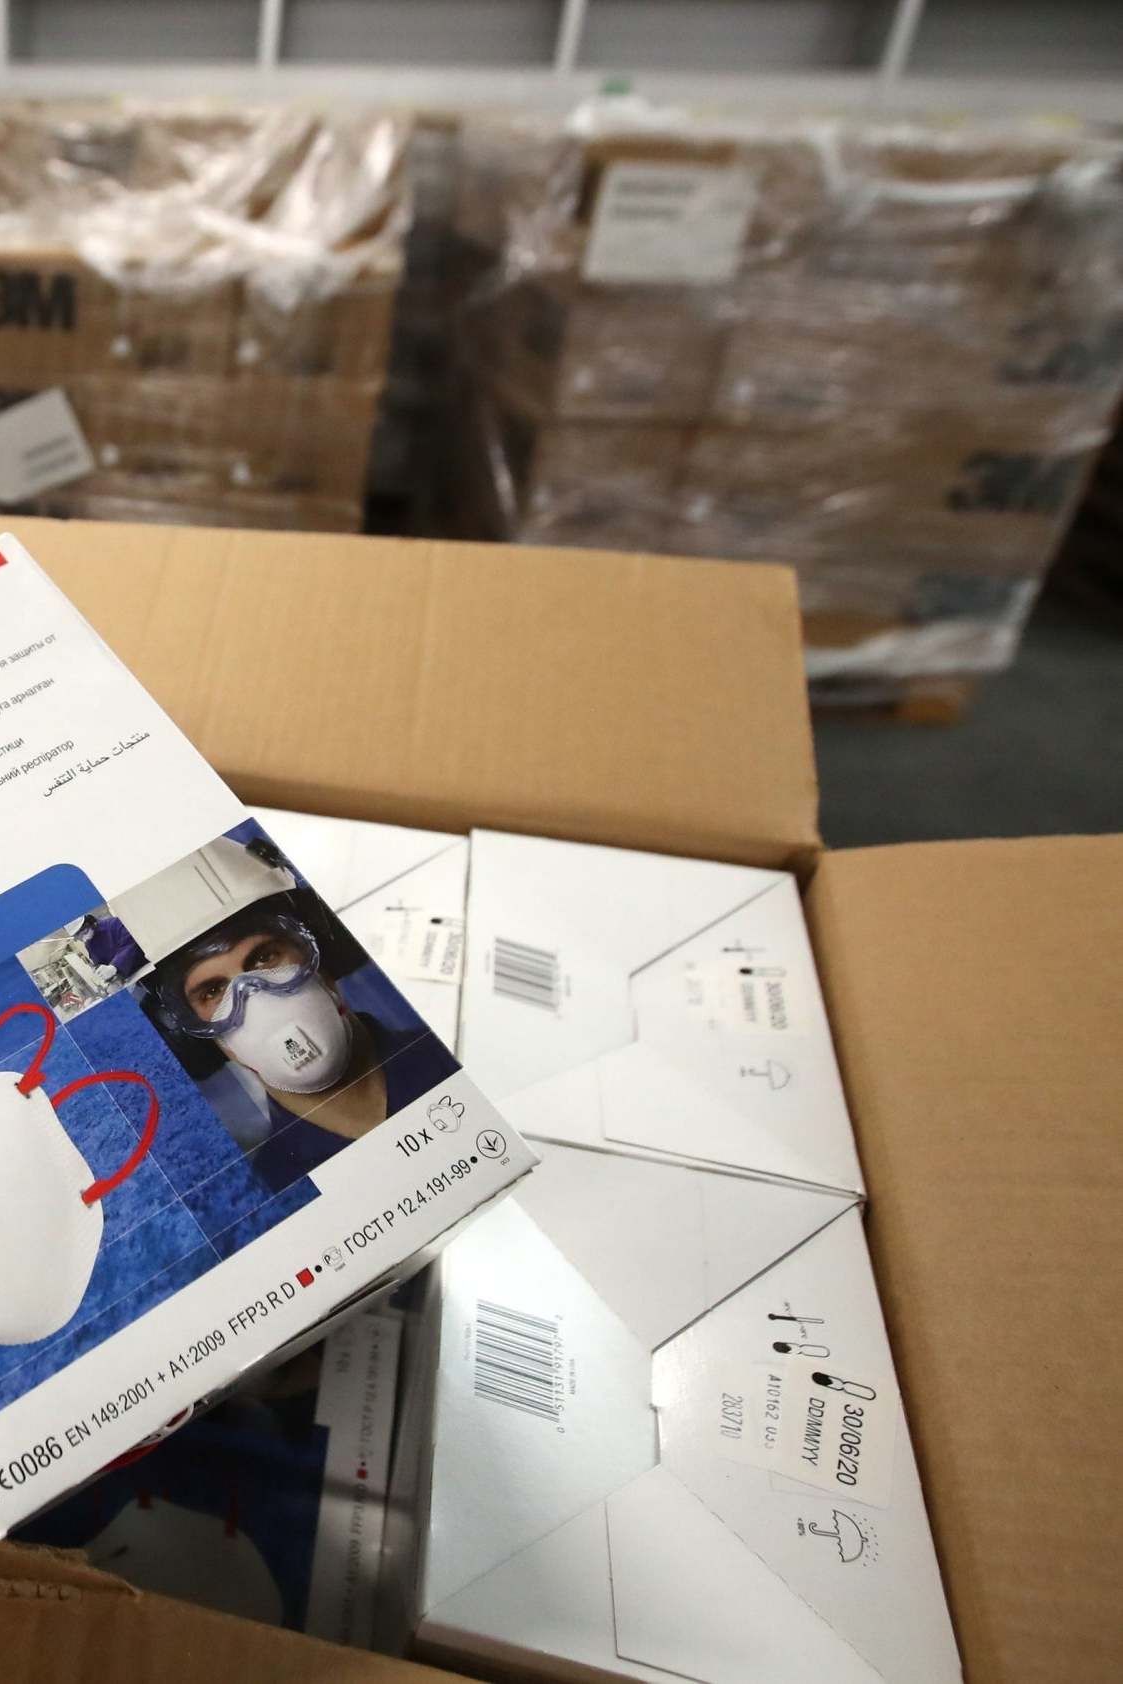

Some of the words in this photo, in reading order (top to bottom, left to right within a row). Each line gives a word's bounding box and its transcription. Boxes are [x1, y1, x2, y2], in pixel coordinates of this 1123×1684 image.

[9, 642, 45, 664] защиты
[45, 633, 57, 645] от
[21, 739, 75, 773] респіратор
[112, 730, 151, 757] منتجات
[43, 769, 78, 798] التنفس
[78, 753, 111, 776] حماية
[343, 1217, 385, 1255] ГОСТ
[397, 1159, 472, 1218] 12.4.191-99
[65, 1420, 91, 1448] EN
[91, 1378, 155, 1429] 149:2001
[158, 1371, 166, 1383] +
[169, 1329, 226, 1378] A1:2009
[228, 1300, 268, 1336] FFP3
[266, 1291, 284, 1310] R
[280, 1282, 296, 1300] D
[766, 1373, 783, 1421] A10162
[801, 1397, 826, 1466] DD/MM/YY
[835, 1404, 865, 1486] 30/06/20
